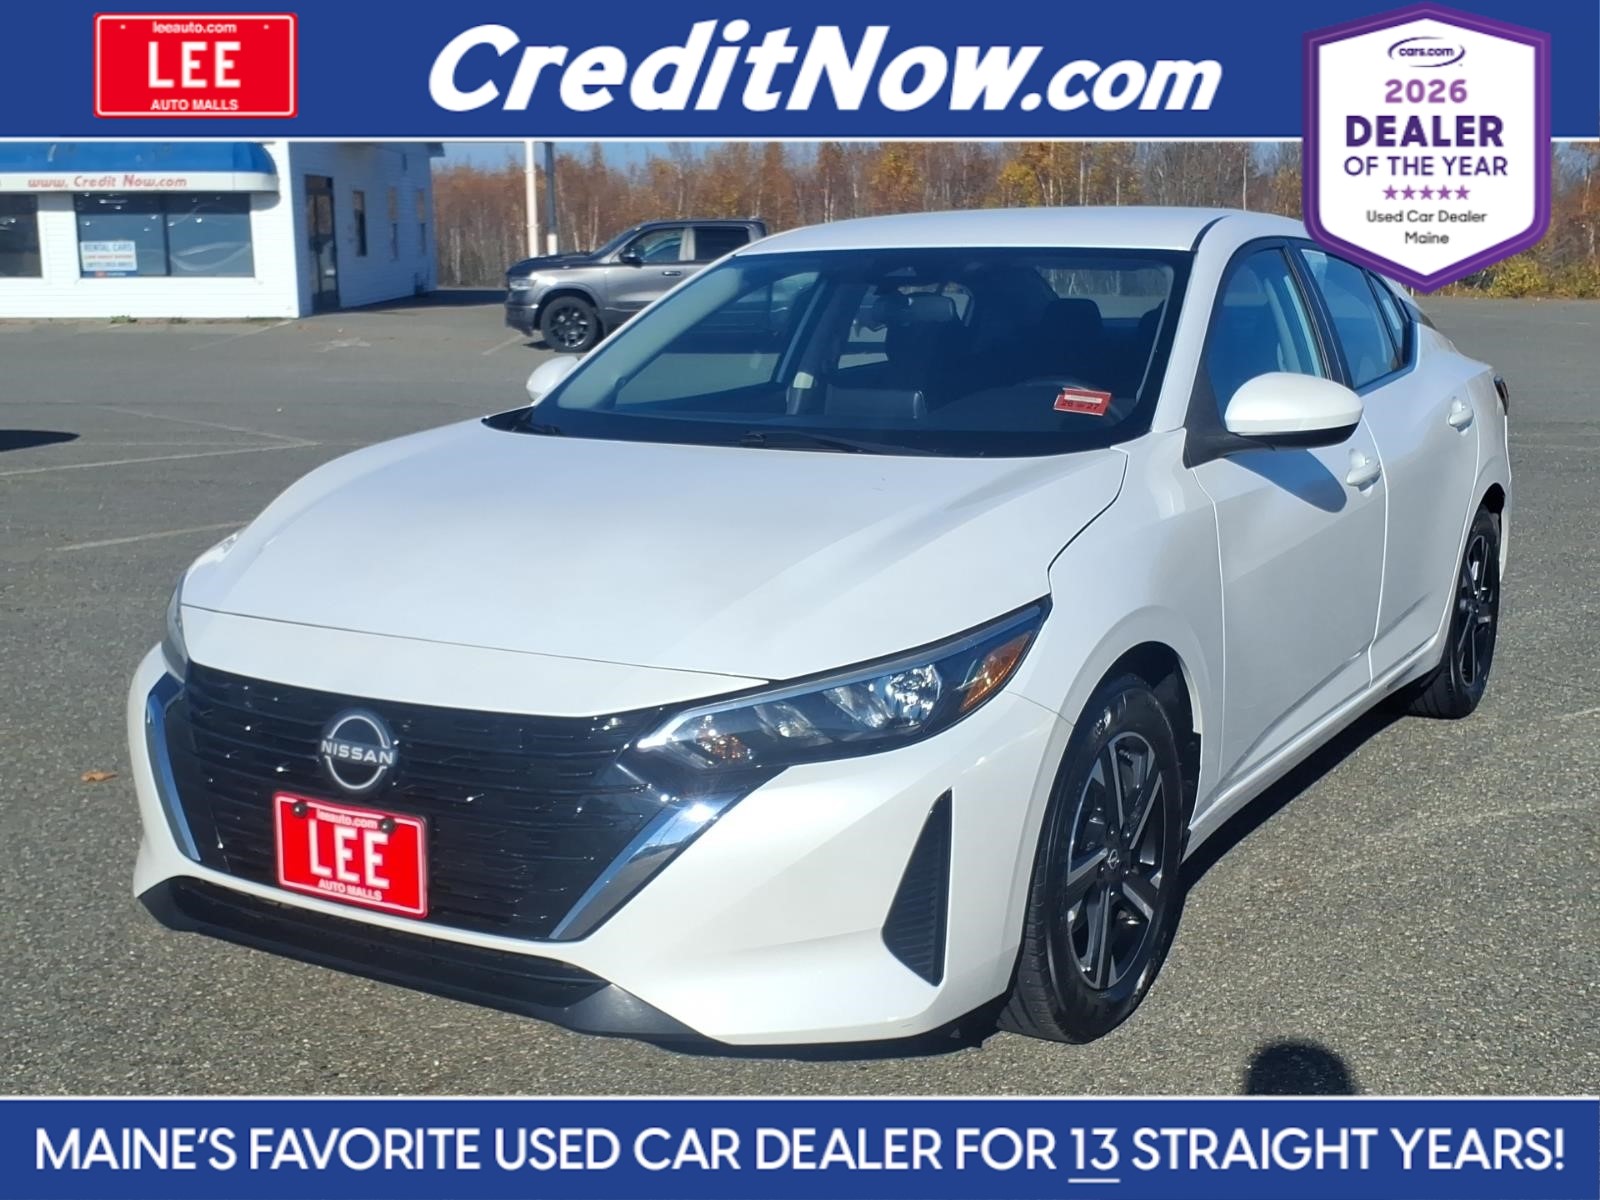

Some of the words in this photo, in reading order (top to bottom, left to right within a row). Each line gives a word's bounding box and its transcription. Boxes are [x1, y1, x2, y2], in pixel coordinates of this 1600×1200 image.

[73, 175, 117, 188] Credit
[321, 740, 393, 764] NISSAN
[308, 818, 390, 890] LEE
[317, 878, 346, 894] AUTO
[346, 884, 383, 902] MALLS
